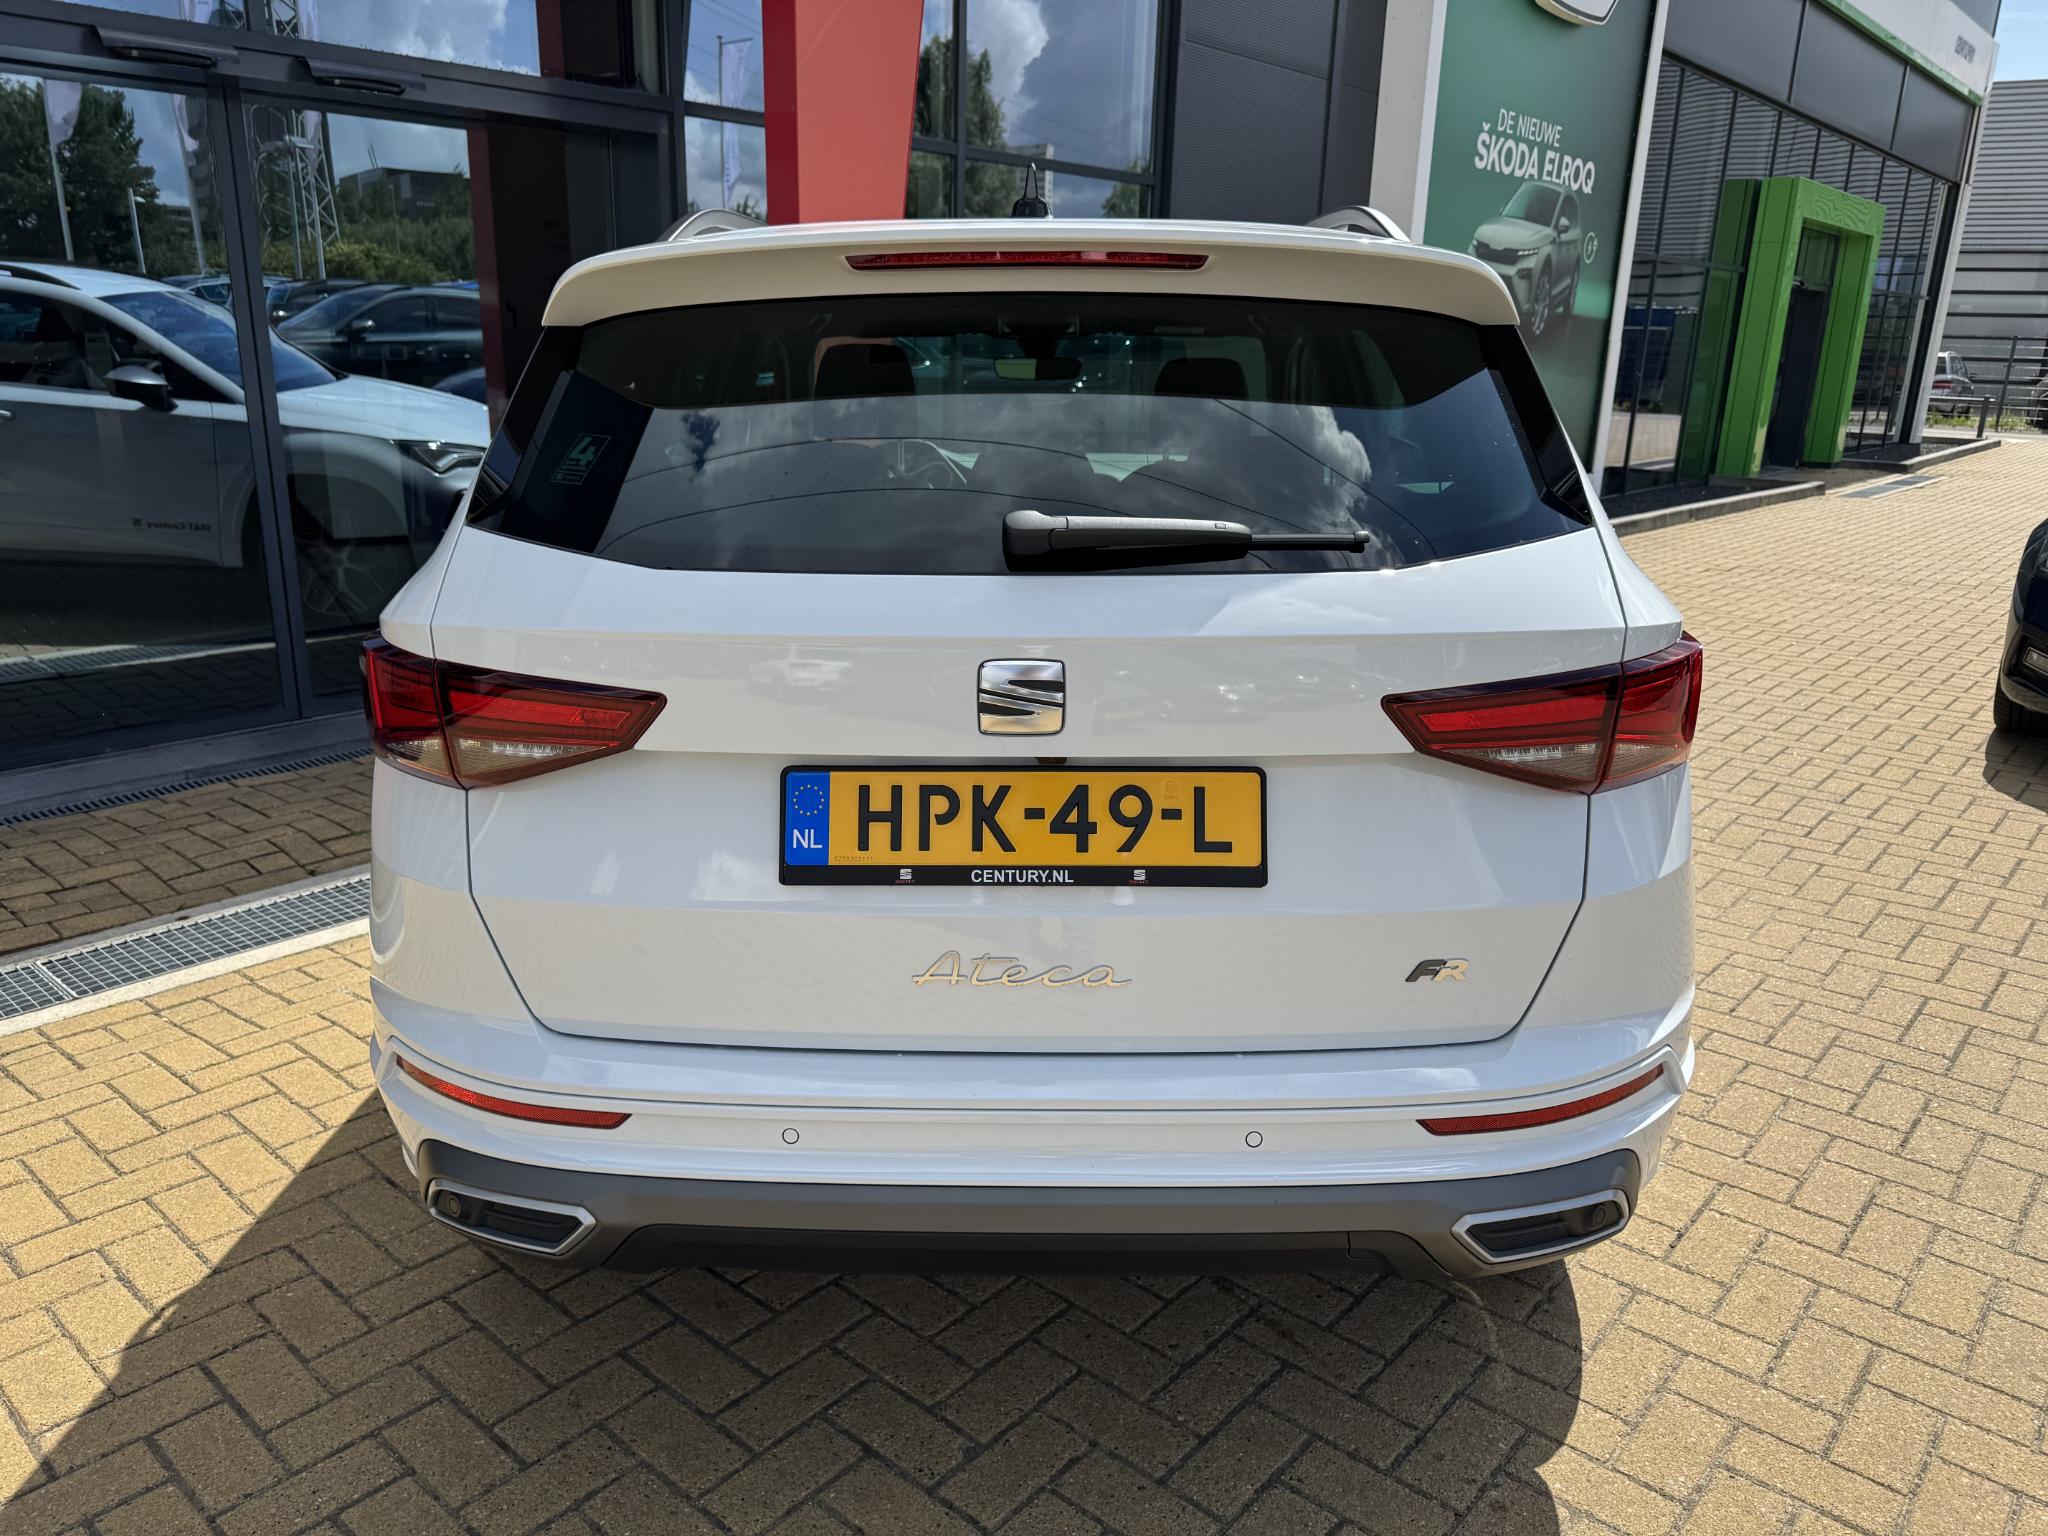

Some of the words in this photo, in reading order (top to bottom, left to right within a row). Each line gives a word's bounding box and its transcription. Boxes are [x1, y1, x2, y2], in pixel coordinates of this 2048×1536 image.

[1497, 108, 1516, 132] DE
[1516, 114, 1563, 147] NIEUWE
[1474, 122, 1539, 180] ŠKODA
[1542, 150, 1597, 194] ELROQ
[857, 783, 1233, 854] HPK-49-L
[792, 828, 823, 850] NL
[970, 868, 1075, 884] CENTURY.NL
[912, 949, 1134, 988] Ateca
[1405, 958, 1470, 983] FR
